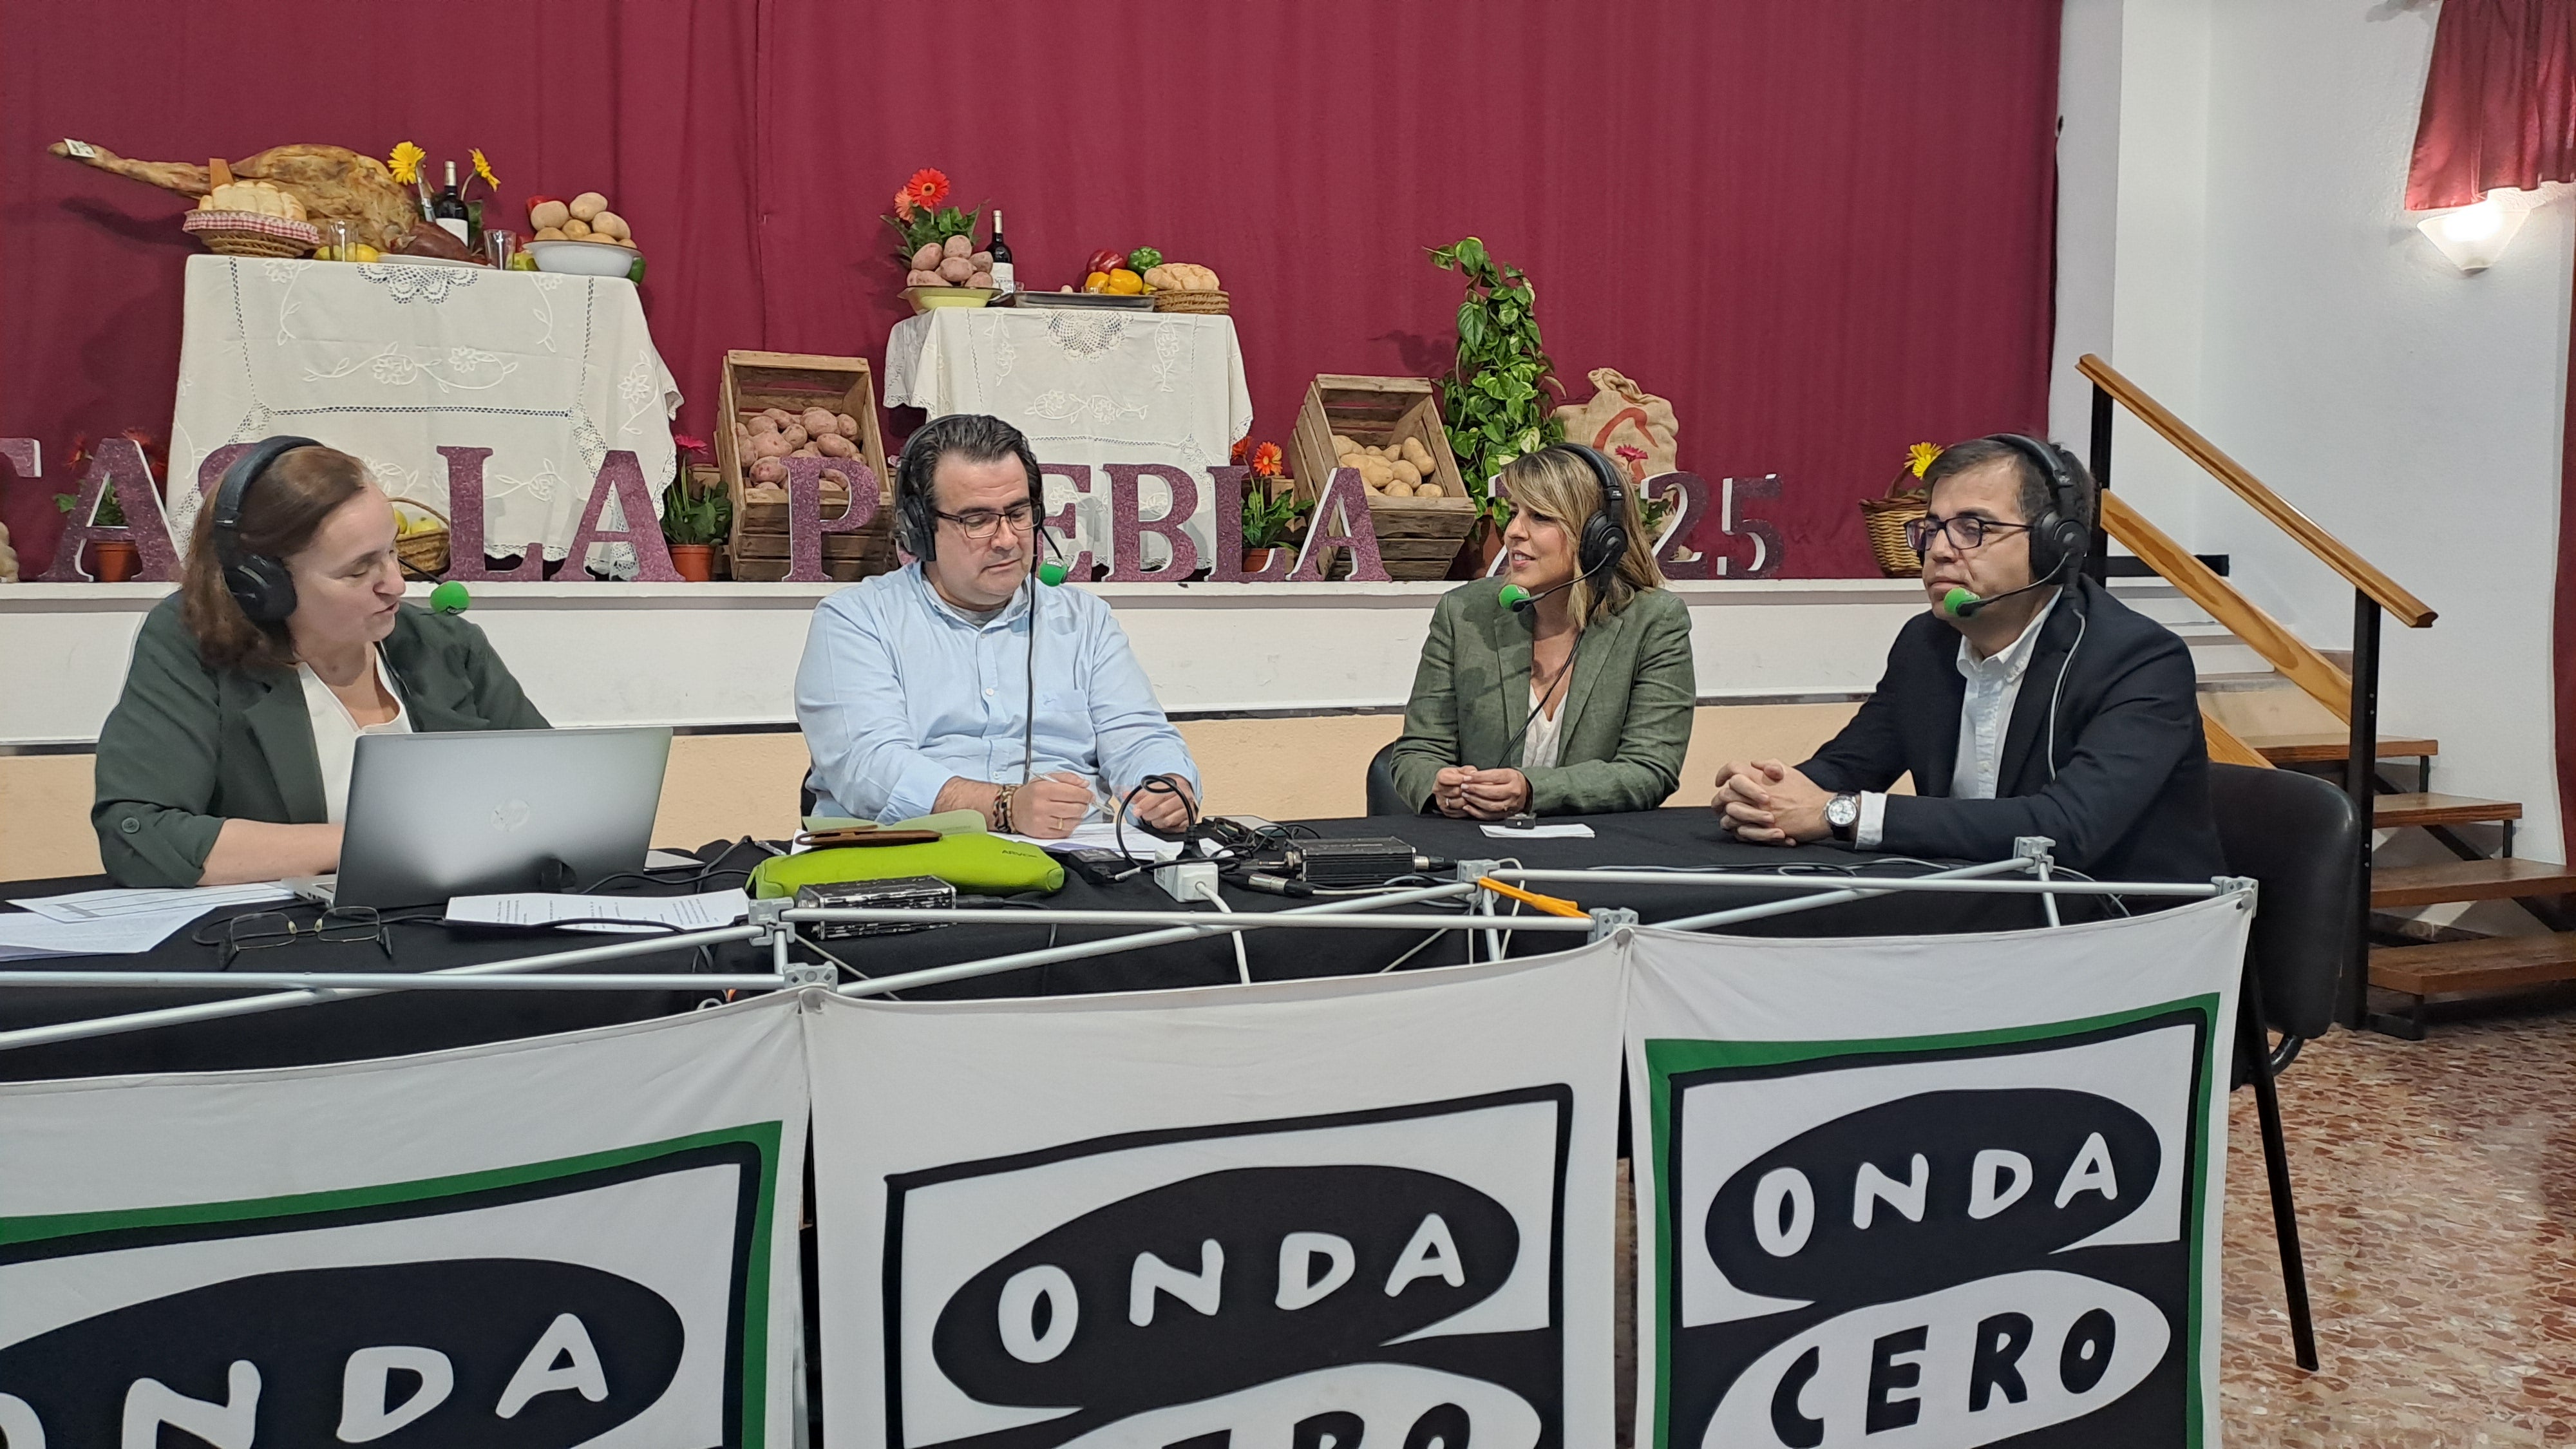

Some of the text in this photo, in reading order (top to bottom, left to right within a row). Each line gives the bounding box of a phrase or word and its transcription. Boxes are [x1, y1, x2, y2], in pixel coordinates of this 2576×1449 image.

[435, 445, 687, 582] LA
[780, 456, 1392, 583] PEBLA
[1754, 1132, 2118, 1258] ONDA
[998, 1213, 1465, 1363] ONDA
[0, 1312, 609, 1449] NDA
[1770, 1307, 2116, 1448] CERO
